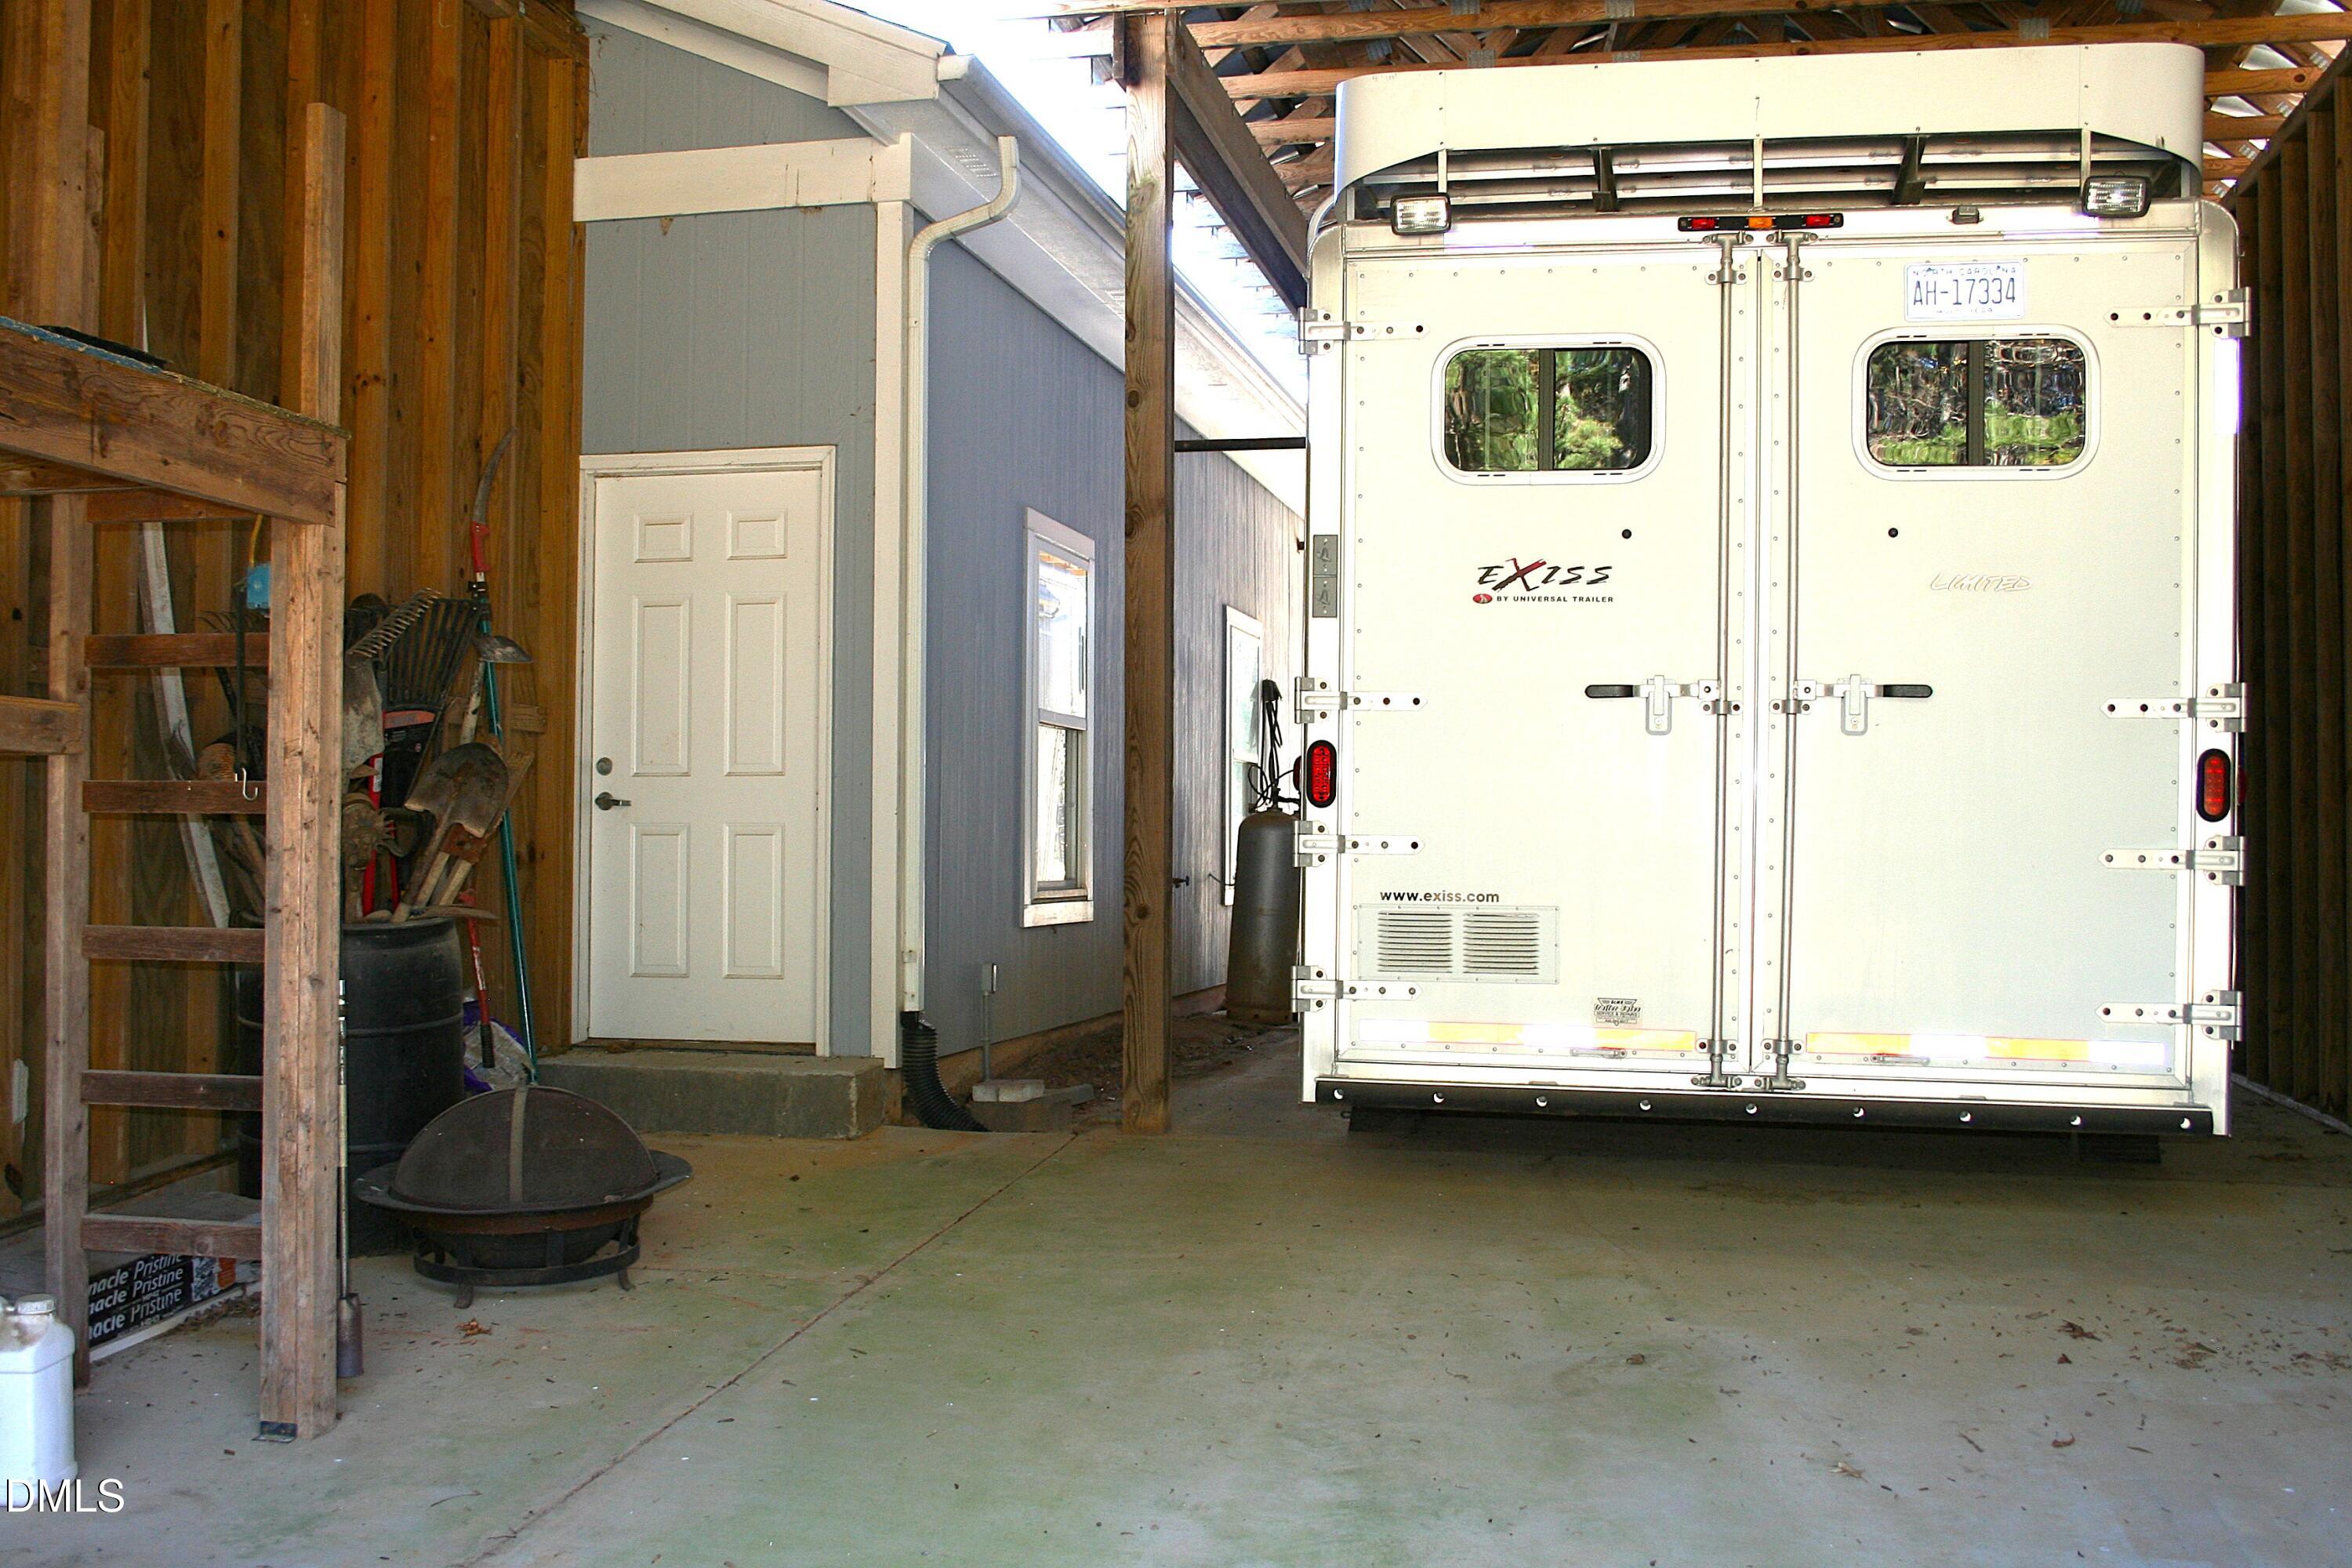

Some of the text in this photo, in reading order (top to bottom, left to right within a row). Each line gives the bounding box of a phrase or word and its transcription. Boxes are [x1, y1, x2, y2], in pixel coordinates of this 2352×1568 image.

[1912, 278, 2016, 306] AH-17334
[1477, 557, 1613, 593] EXISS
[1929, 572, 2032, 592] LIMITED
[1380, 890, 1501, 903] www.exiss.com
[133, 1254, 183, 1280] Pristine
[132, 1268, 184, 1298] Pristine
[130, 1288, 183, 1323] Pristine
